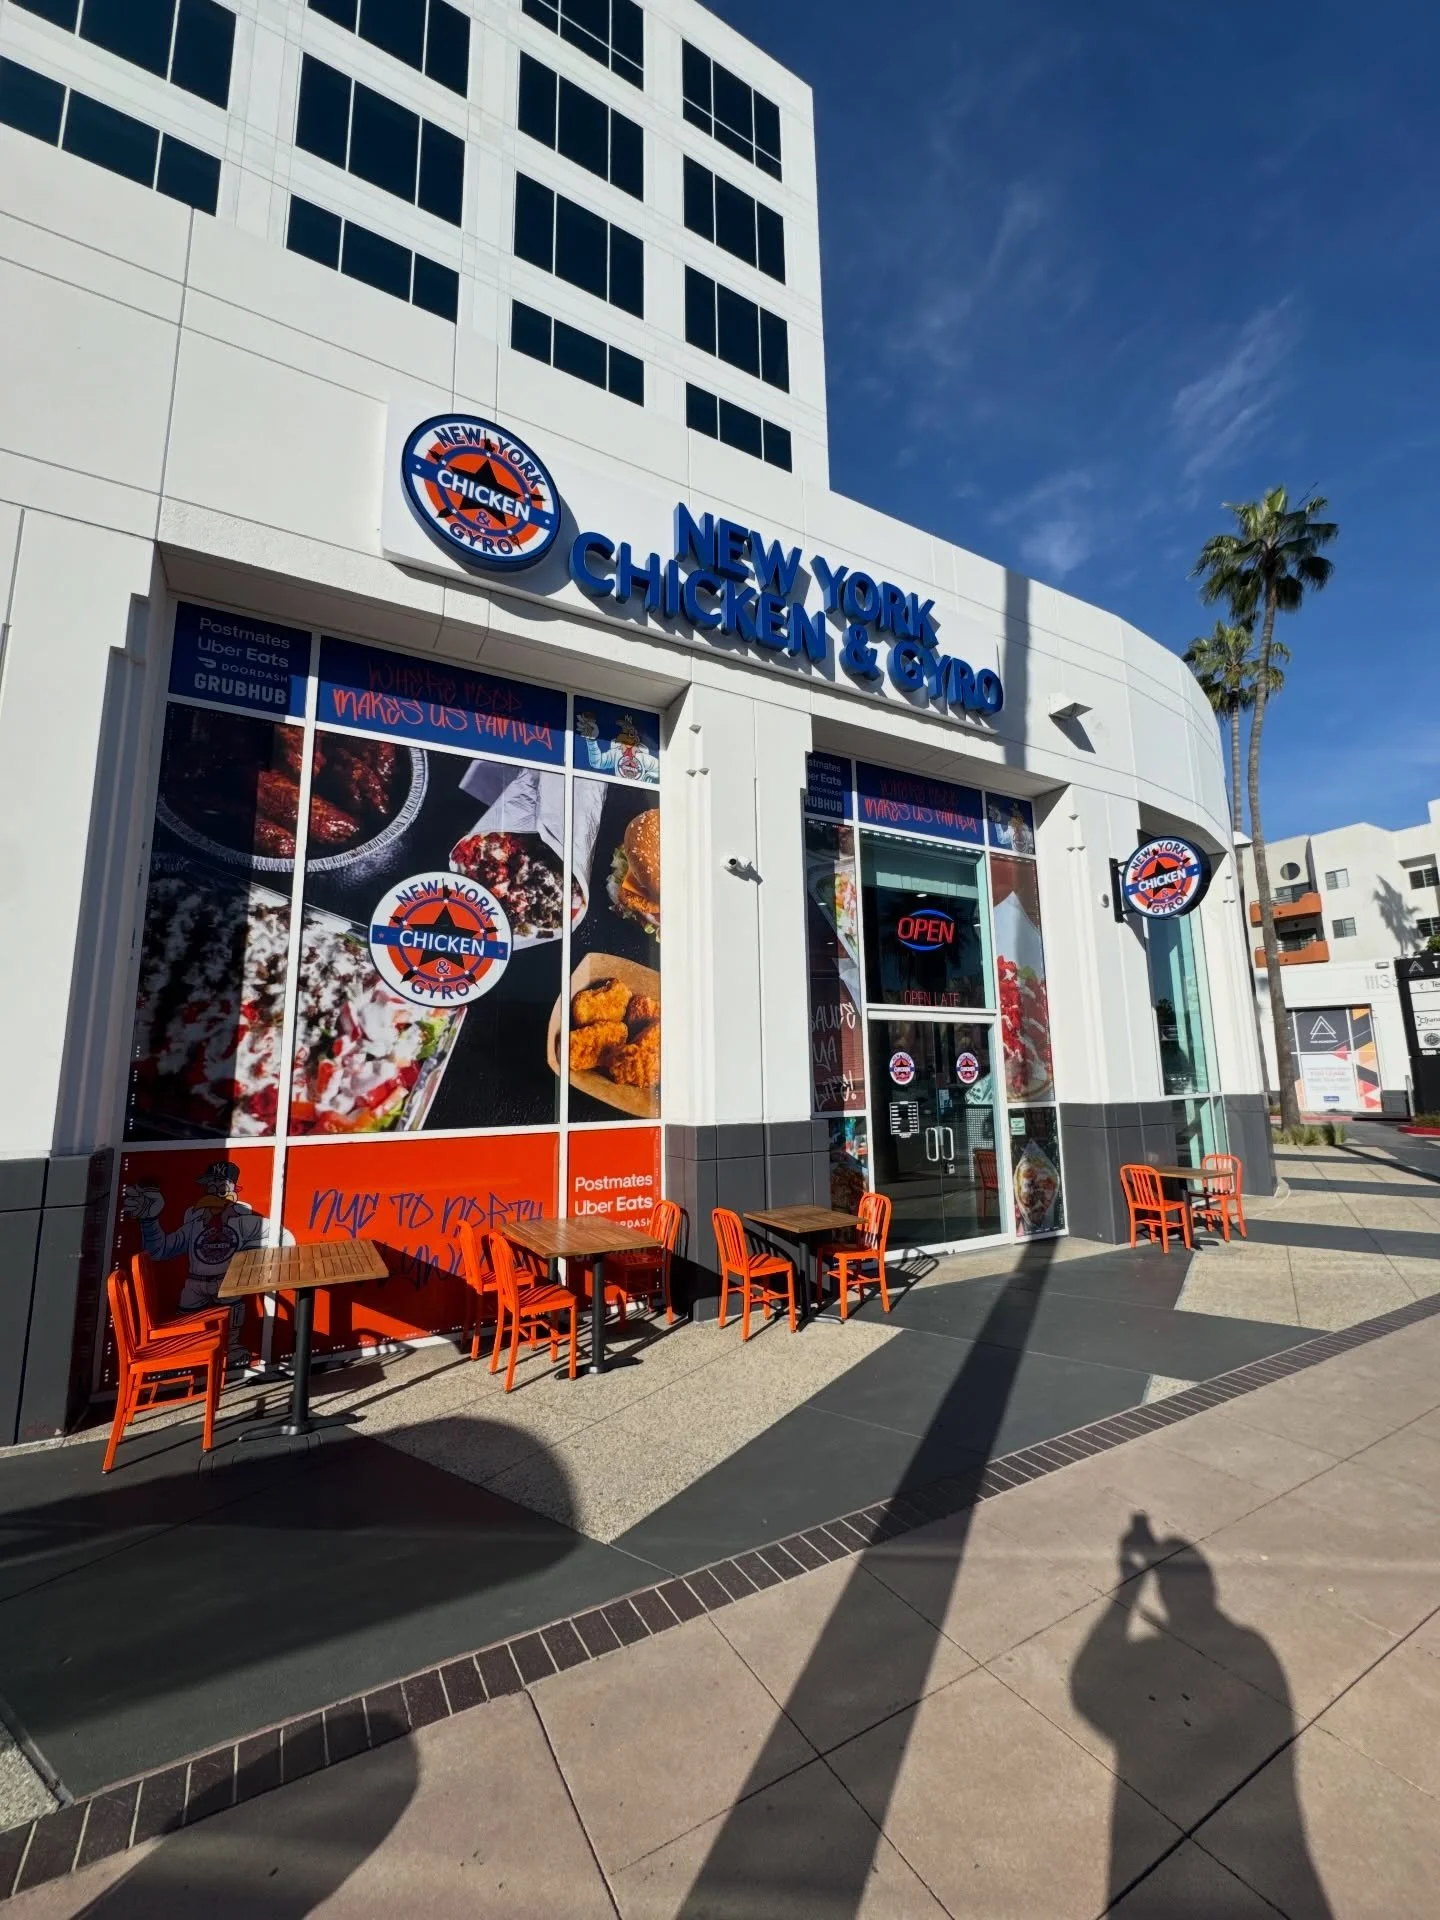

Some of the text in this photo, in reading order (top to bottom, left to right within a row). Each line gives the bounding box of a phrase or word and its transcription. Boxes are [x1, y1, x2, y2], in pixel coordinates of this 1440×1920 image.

[434, 425, 547, 489] NEW YORK
[437, 469, 530, 521] CHICKEN
[475, 511, 491, 527] &
[449, 522, 513, 555] GYRO
[674, 502, 938, 648] NEW YORK
[199, 616, 291, 650] Postmates
[569, 531, 1004, 717] CHICKEN & GYRO
[197, 635, 289, 668] Uber Eats
[221, 663, 288, 683] DOORDASH
[193, 672, 287, 705] GRUBHUB
[332, 688, 554, 751] MAKES US FAMILY
[1131, 841, 1188, 870] NEW YORK
[1139, 869, 1186, 891] CHICKEN
[395, 879, 499, 922] NEW YORK
[1152, 897, 1183, 913] GYRO
[399, 930, 486, 957] CHICKEN
[897, 916, 956, 945] OPEN
[436, 960, 451, 975] &
[411, 979, 470, 1000] GYRO
[904, 990, 932, 1006] OPEN
[574, 1173, 653, 1193] Postmates
[308, 1188, 380, 1239] NYC
[389, 1191, 434, 1229] TO
[574, 1193, 653, 1216] Uber Eats
